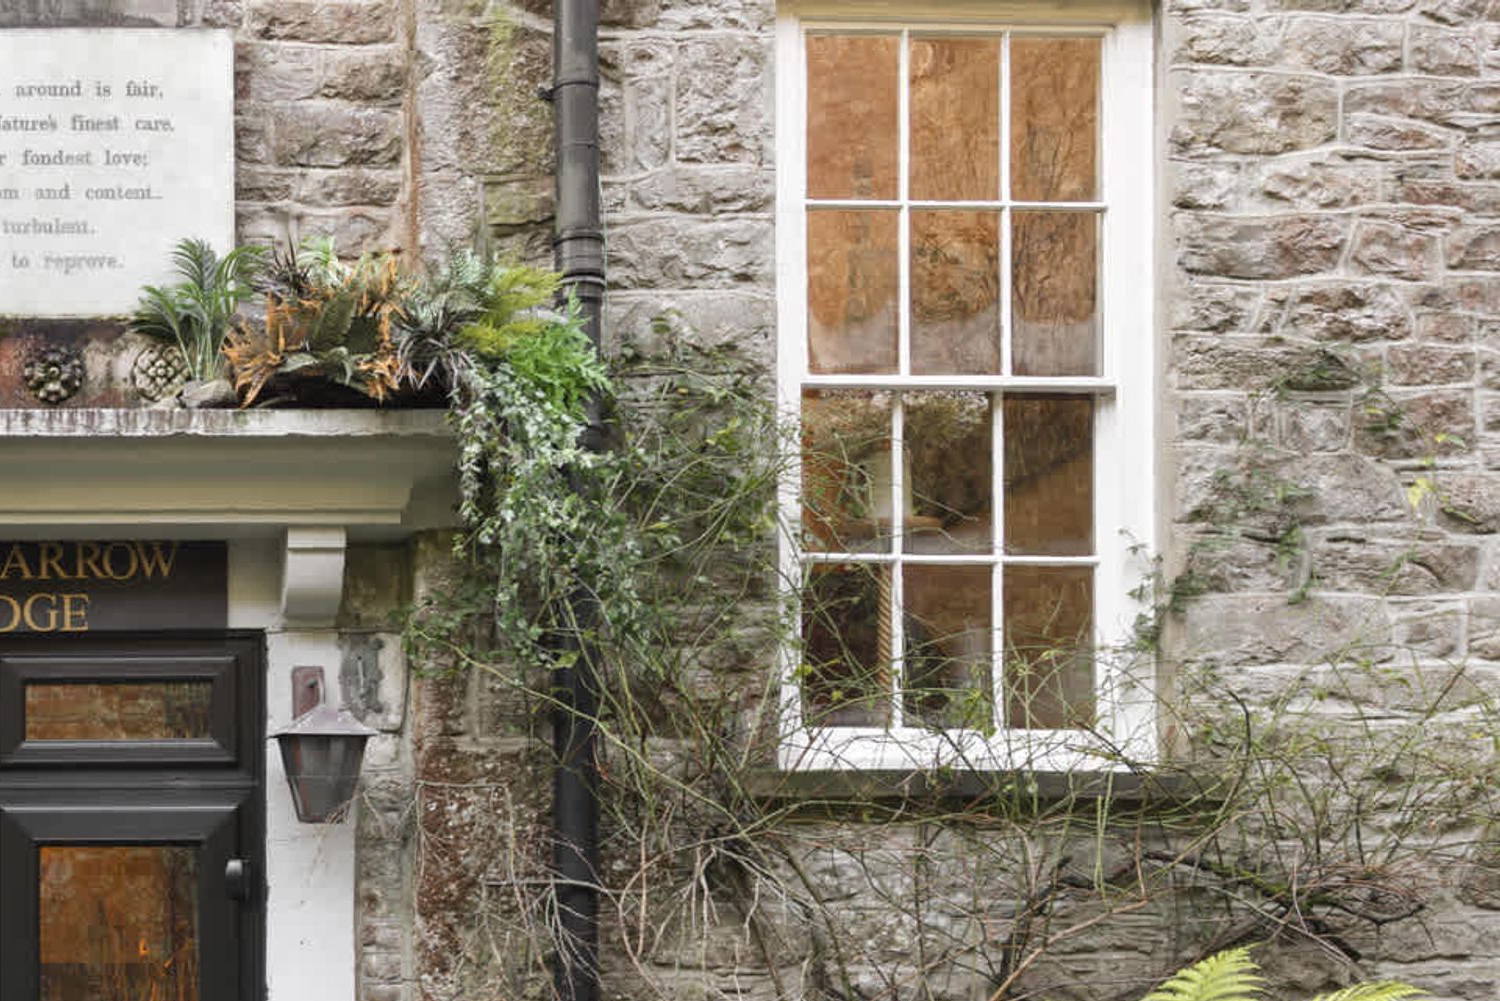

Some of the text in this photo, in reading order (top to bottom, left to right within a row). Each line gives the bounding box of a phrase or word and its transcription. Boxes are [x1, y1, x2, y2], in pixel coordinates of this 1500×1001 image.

[15, 80, 82, 98] around
[95, 80, 111, 98] is
[71, 115, 119, 132] finest
[22, 149, 92, 166] fondest
[36, 182, 70, 200] and
[12, 253, 29, 269] to
